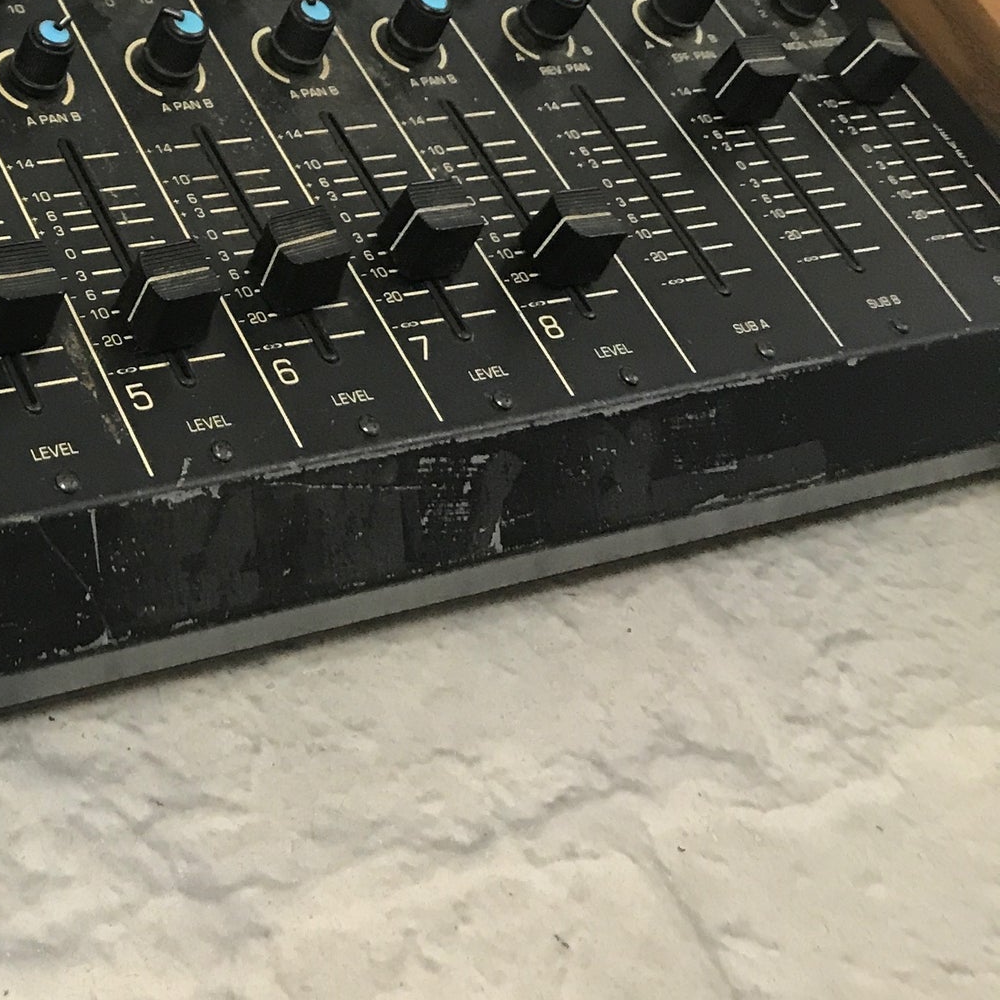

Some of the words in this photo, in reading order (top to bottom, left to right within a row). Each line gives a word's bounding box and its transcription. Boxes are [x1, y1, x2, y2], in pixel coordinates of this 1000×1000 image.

[162, 103, 172, 112] A
[173, 100, 202, 110] PAN
[27, 117, 37, 126] A
[39, 113, 68, 124] PAN
[70, 112, 81, 121] B
[286, 129, 302, 139] 14
[155, 144, 172, 153] 14
[428, 145, 447, 155] 10
[16, 159, 34, 169] 14
[304, 159, 321, 170] 10
[443, 162, 454, 172] 6
[172, 175, 190, 185] 10
[319, 178, 329, 187] 6
[602, 179, 613, 188] 0
[32, 191, 51, 202] 10
[187, 193, 197, 203] 6
[327, 191, 338, 201] 3
[46, 211, 57, 221] 6
[194, 208, 205, 218] 3
[340, 212, 351, 222] 0
[53, 226, 64, 236] 3
[207, 230, 218, 240] 0
[352, 232, 363, 243] 3
[489, 232, 500, 242] 6
[65, 249, 76, 259] 0
[218, 251, 230, 261] 3
[364, 250, 374, 260] 6
[497, 248, 515, 259] 10
[650, 251, 669, 262] 20
[76, 271, 87, 281] 3
[228, 269, 240, 280] 6
[370, 267, 391, 278] 10
[509, 272, 530, 283] 20
[85, 290, 96, 300] 6
[235, 286, 255, 298] 10
[383, 291, 404, 303] 20
[866, 295, 893, 308] SUB
[90, 308, 109, 319] 10
[247, 312, 269, 324] 20
[537, 316, 564, 341] 8
[733, 321, 759, 334] SUB
[758, 319, 770, 330] A
[102, 334, 122, 347] 20
[407, 336, 428, 362] 7
[594, 344, 633, 358] LEVEL
[273, 359, 299, 384] 6
[468, 366, 509, 381] LEVEL
[126, 383, 153, 410] 5
[331, 390, 374, 406] LEVEL
[186, 415, 232, 432] LEVEL
[30, 443, 79, 461] LEVEL
